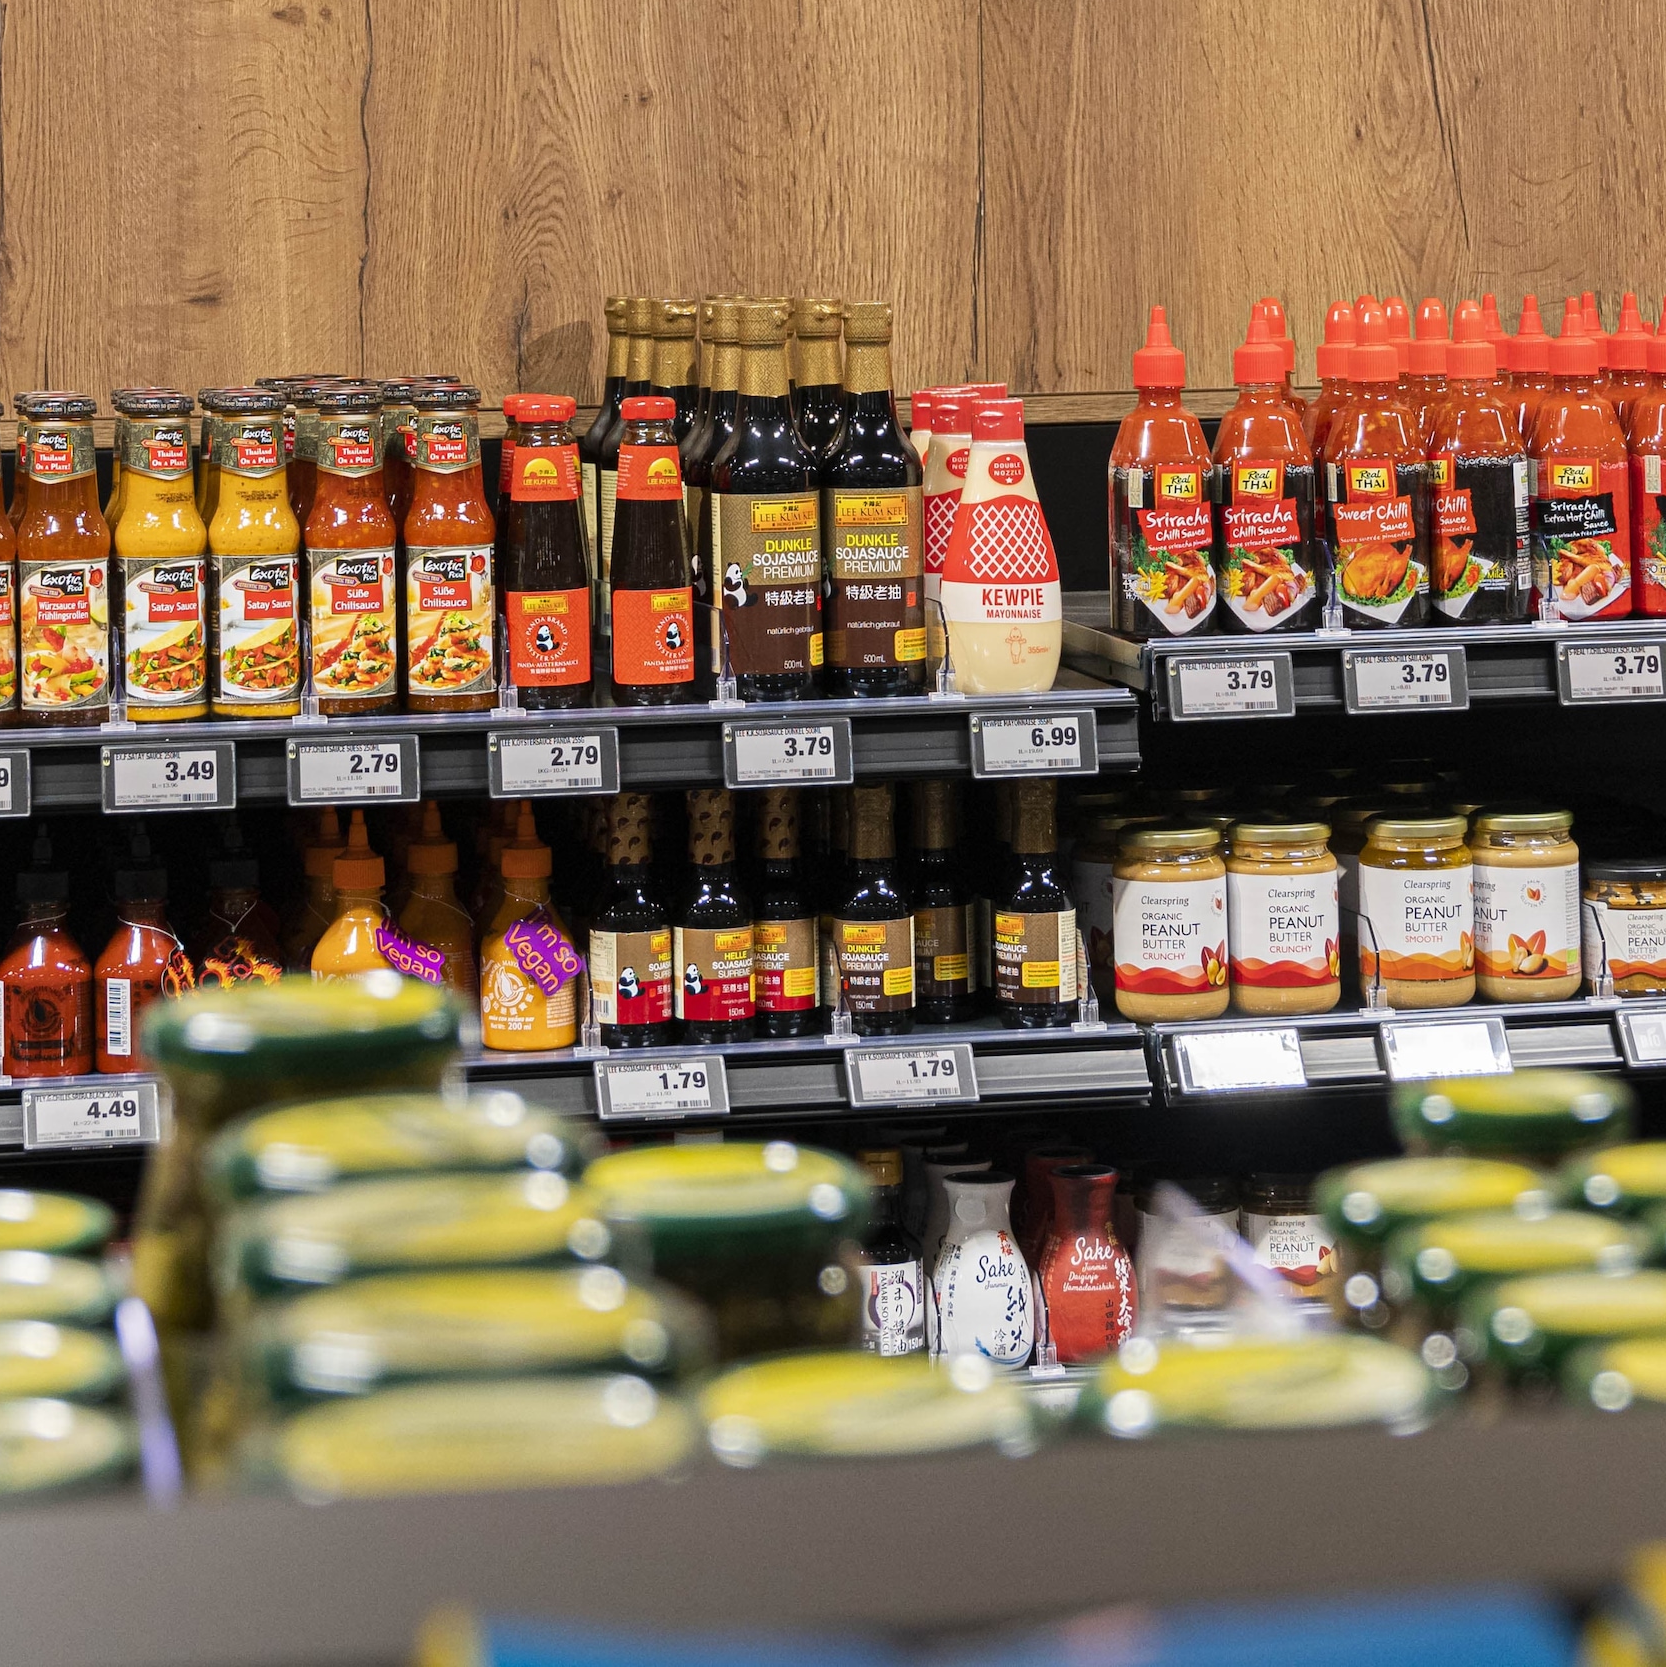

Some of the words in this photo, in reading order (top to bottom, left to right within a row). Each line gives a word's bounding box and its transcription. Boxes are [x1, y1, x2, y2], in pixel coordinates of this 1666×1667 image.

[993, 462, 1021, 470] DOUBLE
[1165, 482, 1193, 494] THAI
[840, 507, 858, 517] LEE
[860, 506, 884, 517] KUM
[886, 505, 902, 516] KEE
[1337, 506, 1373, 521] Sweet
[1376, 502, 1408, 519] Chilli
[1551, 500, 1599, 511] Sriracha
[1145, 510, 1209, 527] Sriracha
[1544, 511, 1565, 524] Extra
[1566, 512, 1582, 523] Hot
[1584, 509, 1605, 521] Chilli
[1380, 520, 1408, 532] Sauce
[1584, 519, 1609, 530] Sauce
[846, 533, 899, 547] DUNKLE
[1155, 529, 1180, 540] Chilli
[1182, 527, 1205, 539] Sauce
[765, 538, 812, 552] DUNKLE
[753, 549, 818, 565] SOJASAUCE
[836, 546, 909, 560] SOJASAUCE
[844, 559, 901, 573] PREMIUM
[845, 584, 902, 601] 特級老抽
[982, 588, 1044, 606] KEWPIE
[38, 601, 74, 611] Würzsauce
[76, 600, 88, 609] für
[151, 601, 174, 612] Satay
[176, 600, 197, 611] Sauce
[38, 610, 89, 621] Frühlingsrollen
[986, 608, 1042, 619] MAYONNAISE
[863, 653, 886, 663] 500mL
[1614, 655, 1659, 674] 3.79
[1402, 663, 1447, 682] 3.79
[1227, 670, 1273, 690] 3.79
[1031, 726, 1077, 747] 6.99
[784, 735, 832, 756] 3.79
[350, 753, 398, 774] 2.79
[550, 747, 598, 766] 2.79
[165, 760, 214, 781] 3.49
[1141, 895, 1189, 907] Clearspring
[1141, 911, 1182, 921] ORGANIC
[1142, 922, 1200, 937] PEANUT
[1143, 938, 1186, 950] BUTTER
[1405, 935, 1443, 944] SMOOTH
[377, 930, 439, 982] Vegan
[414, 944, 440, 963] so
[724, 950, 747, 960] HELLE
[1143, 952, 1186, 961] CRUNCHY
[712, 958, 753, 969] SOJASAUCE
[718, 967, 751, 977] SUPREME
[908, 1059, 955, 1078] 1.79
[659, 1072, 706, 1090] 1.79
[87, 1100, 137, 1119] 4.49
[1071, 1236, 1114, 1266] Sake
[976, 1255, 1016, 1283] Sake
